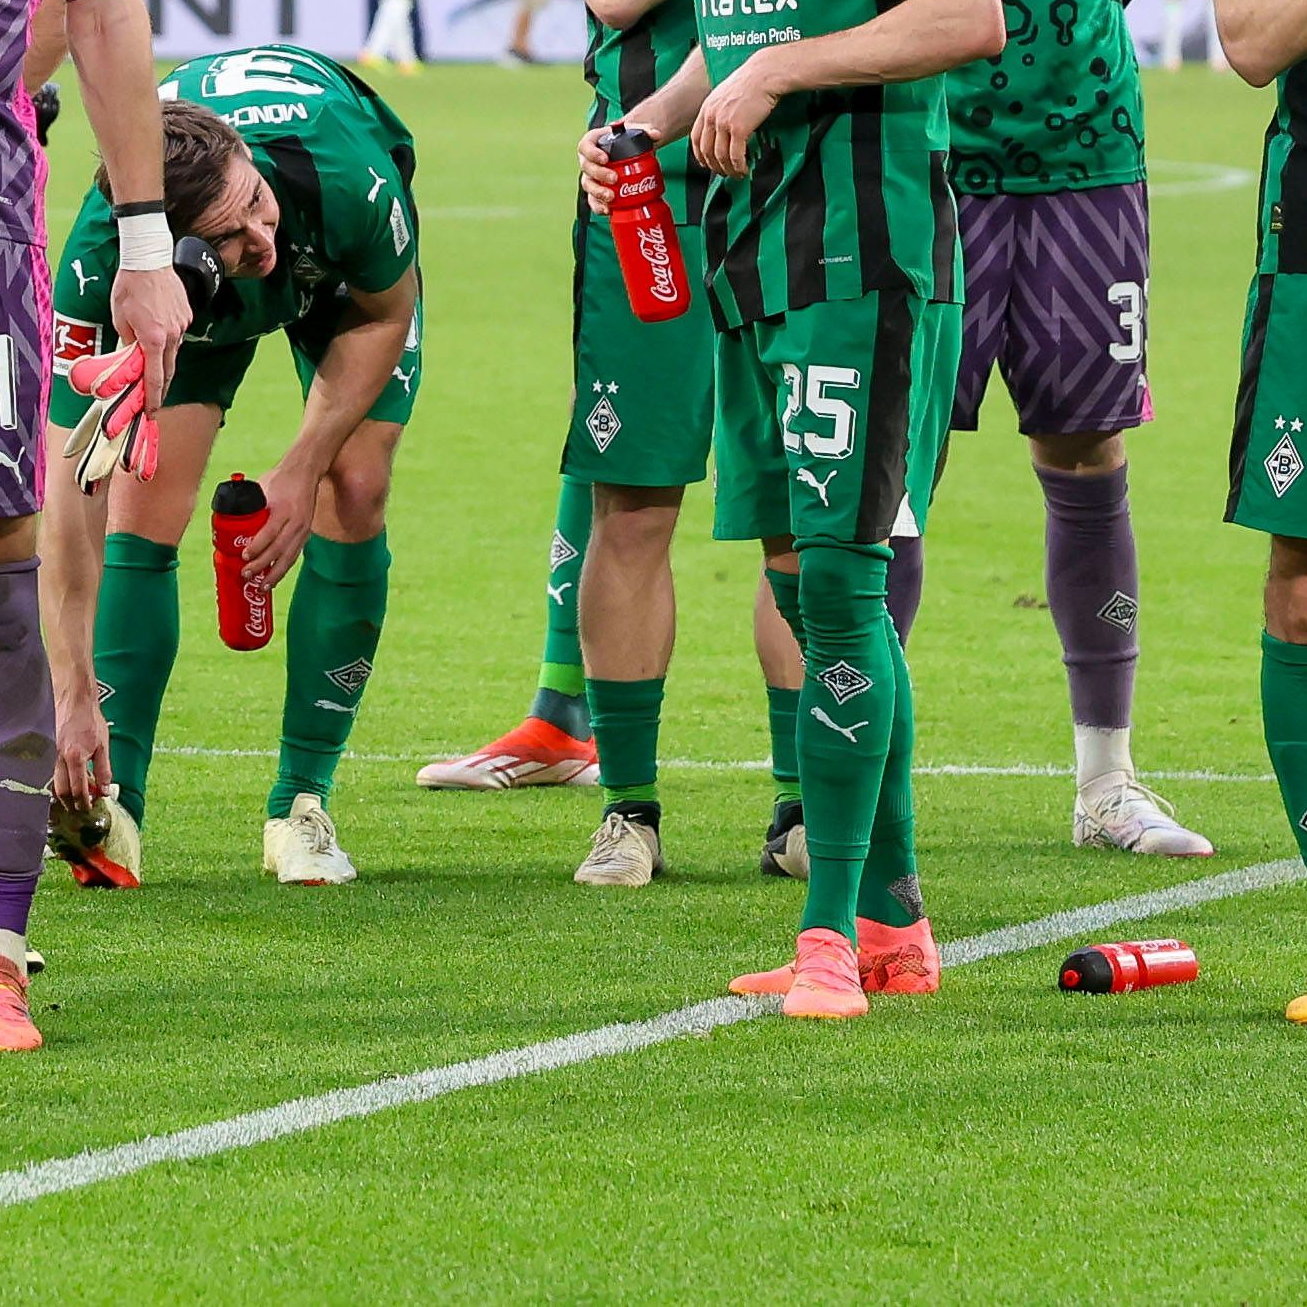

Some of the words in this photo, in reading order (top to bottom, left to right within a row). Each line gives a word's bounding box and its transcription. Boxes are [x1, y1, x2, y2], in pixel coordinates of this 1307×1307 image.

[731, 30, 745, 47] bei
[747, 29, 768, 45] den
[768, 26, 802, 44] Profis
[219, 102, 309, 127] MÖNCH
[619, 174, 659, 198] Coca-Cola
[636, 223, 678, 302] Coca-Cola
[782, 363, 861, 460] 25
